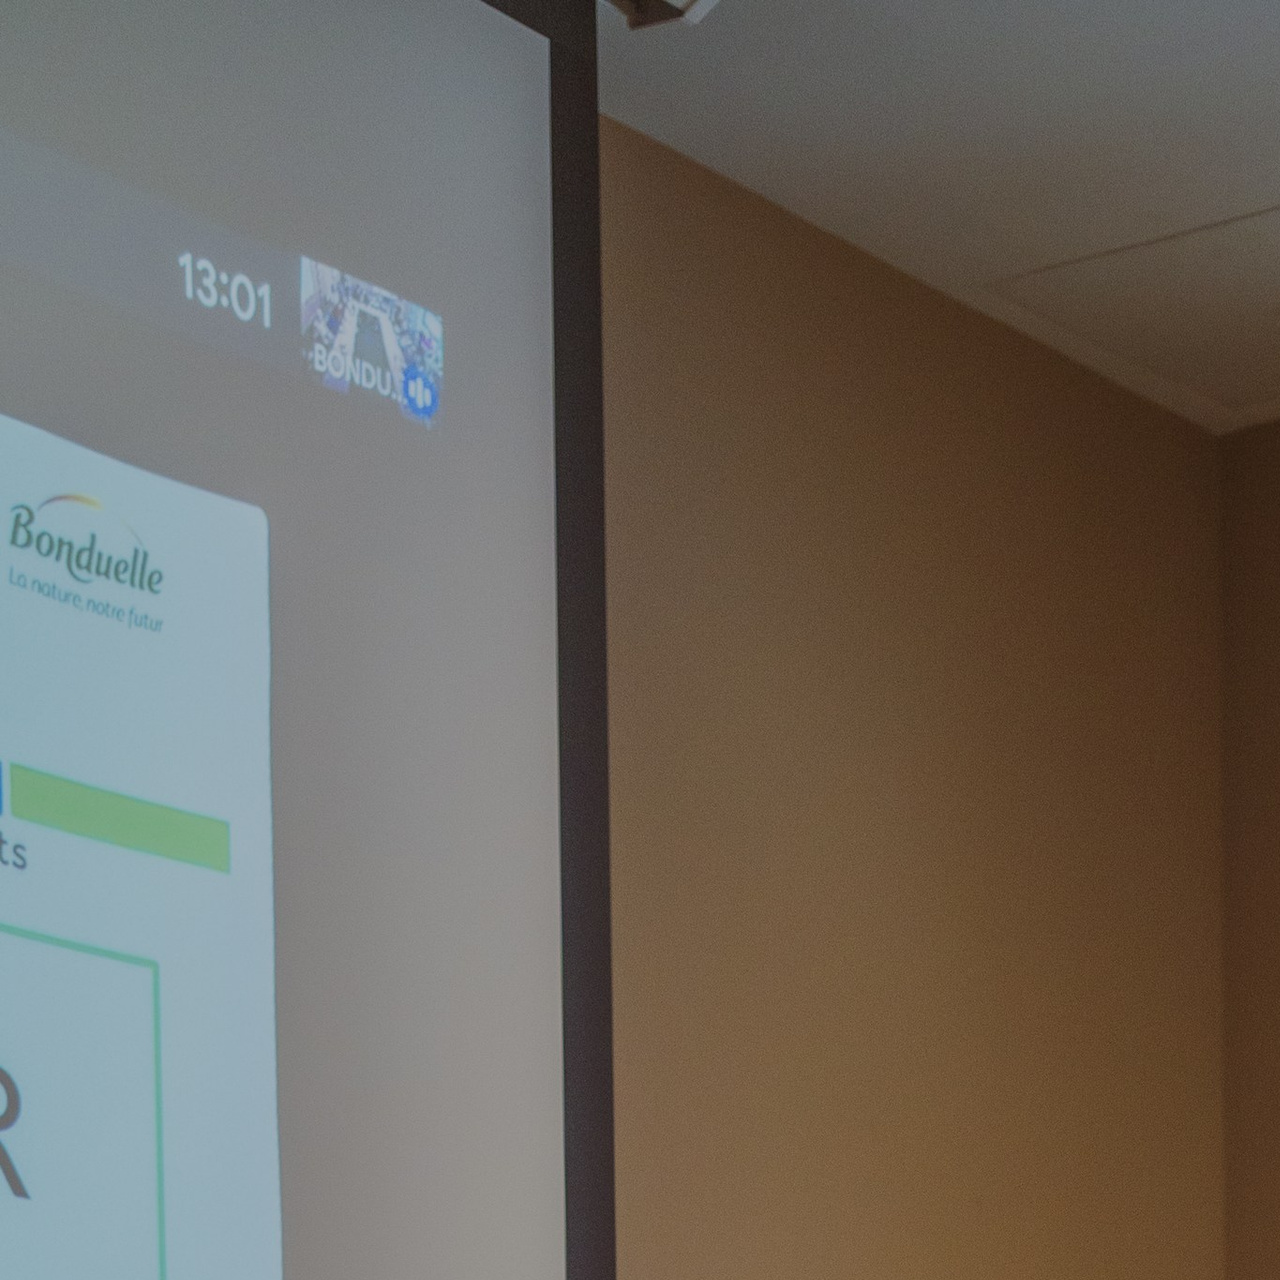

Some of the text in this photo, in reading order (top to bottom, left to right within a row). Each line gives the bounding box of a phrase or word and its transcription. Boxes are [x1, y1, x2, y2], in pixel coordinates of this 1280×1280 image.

[178, 252, 271, 329] 13:01
[10, 504, 163, 594] Bonduelle
[9, 566, 27, 589] La
[86, 599, 126, 622] notre
[127, 606, 164, 632] futur
